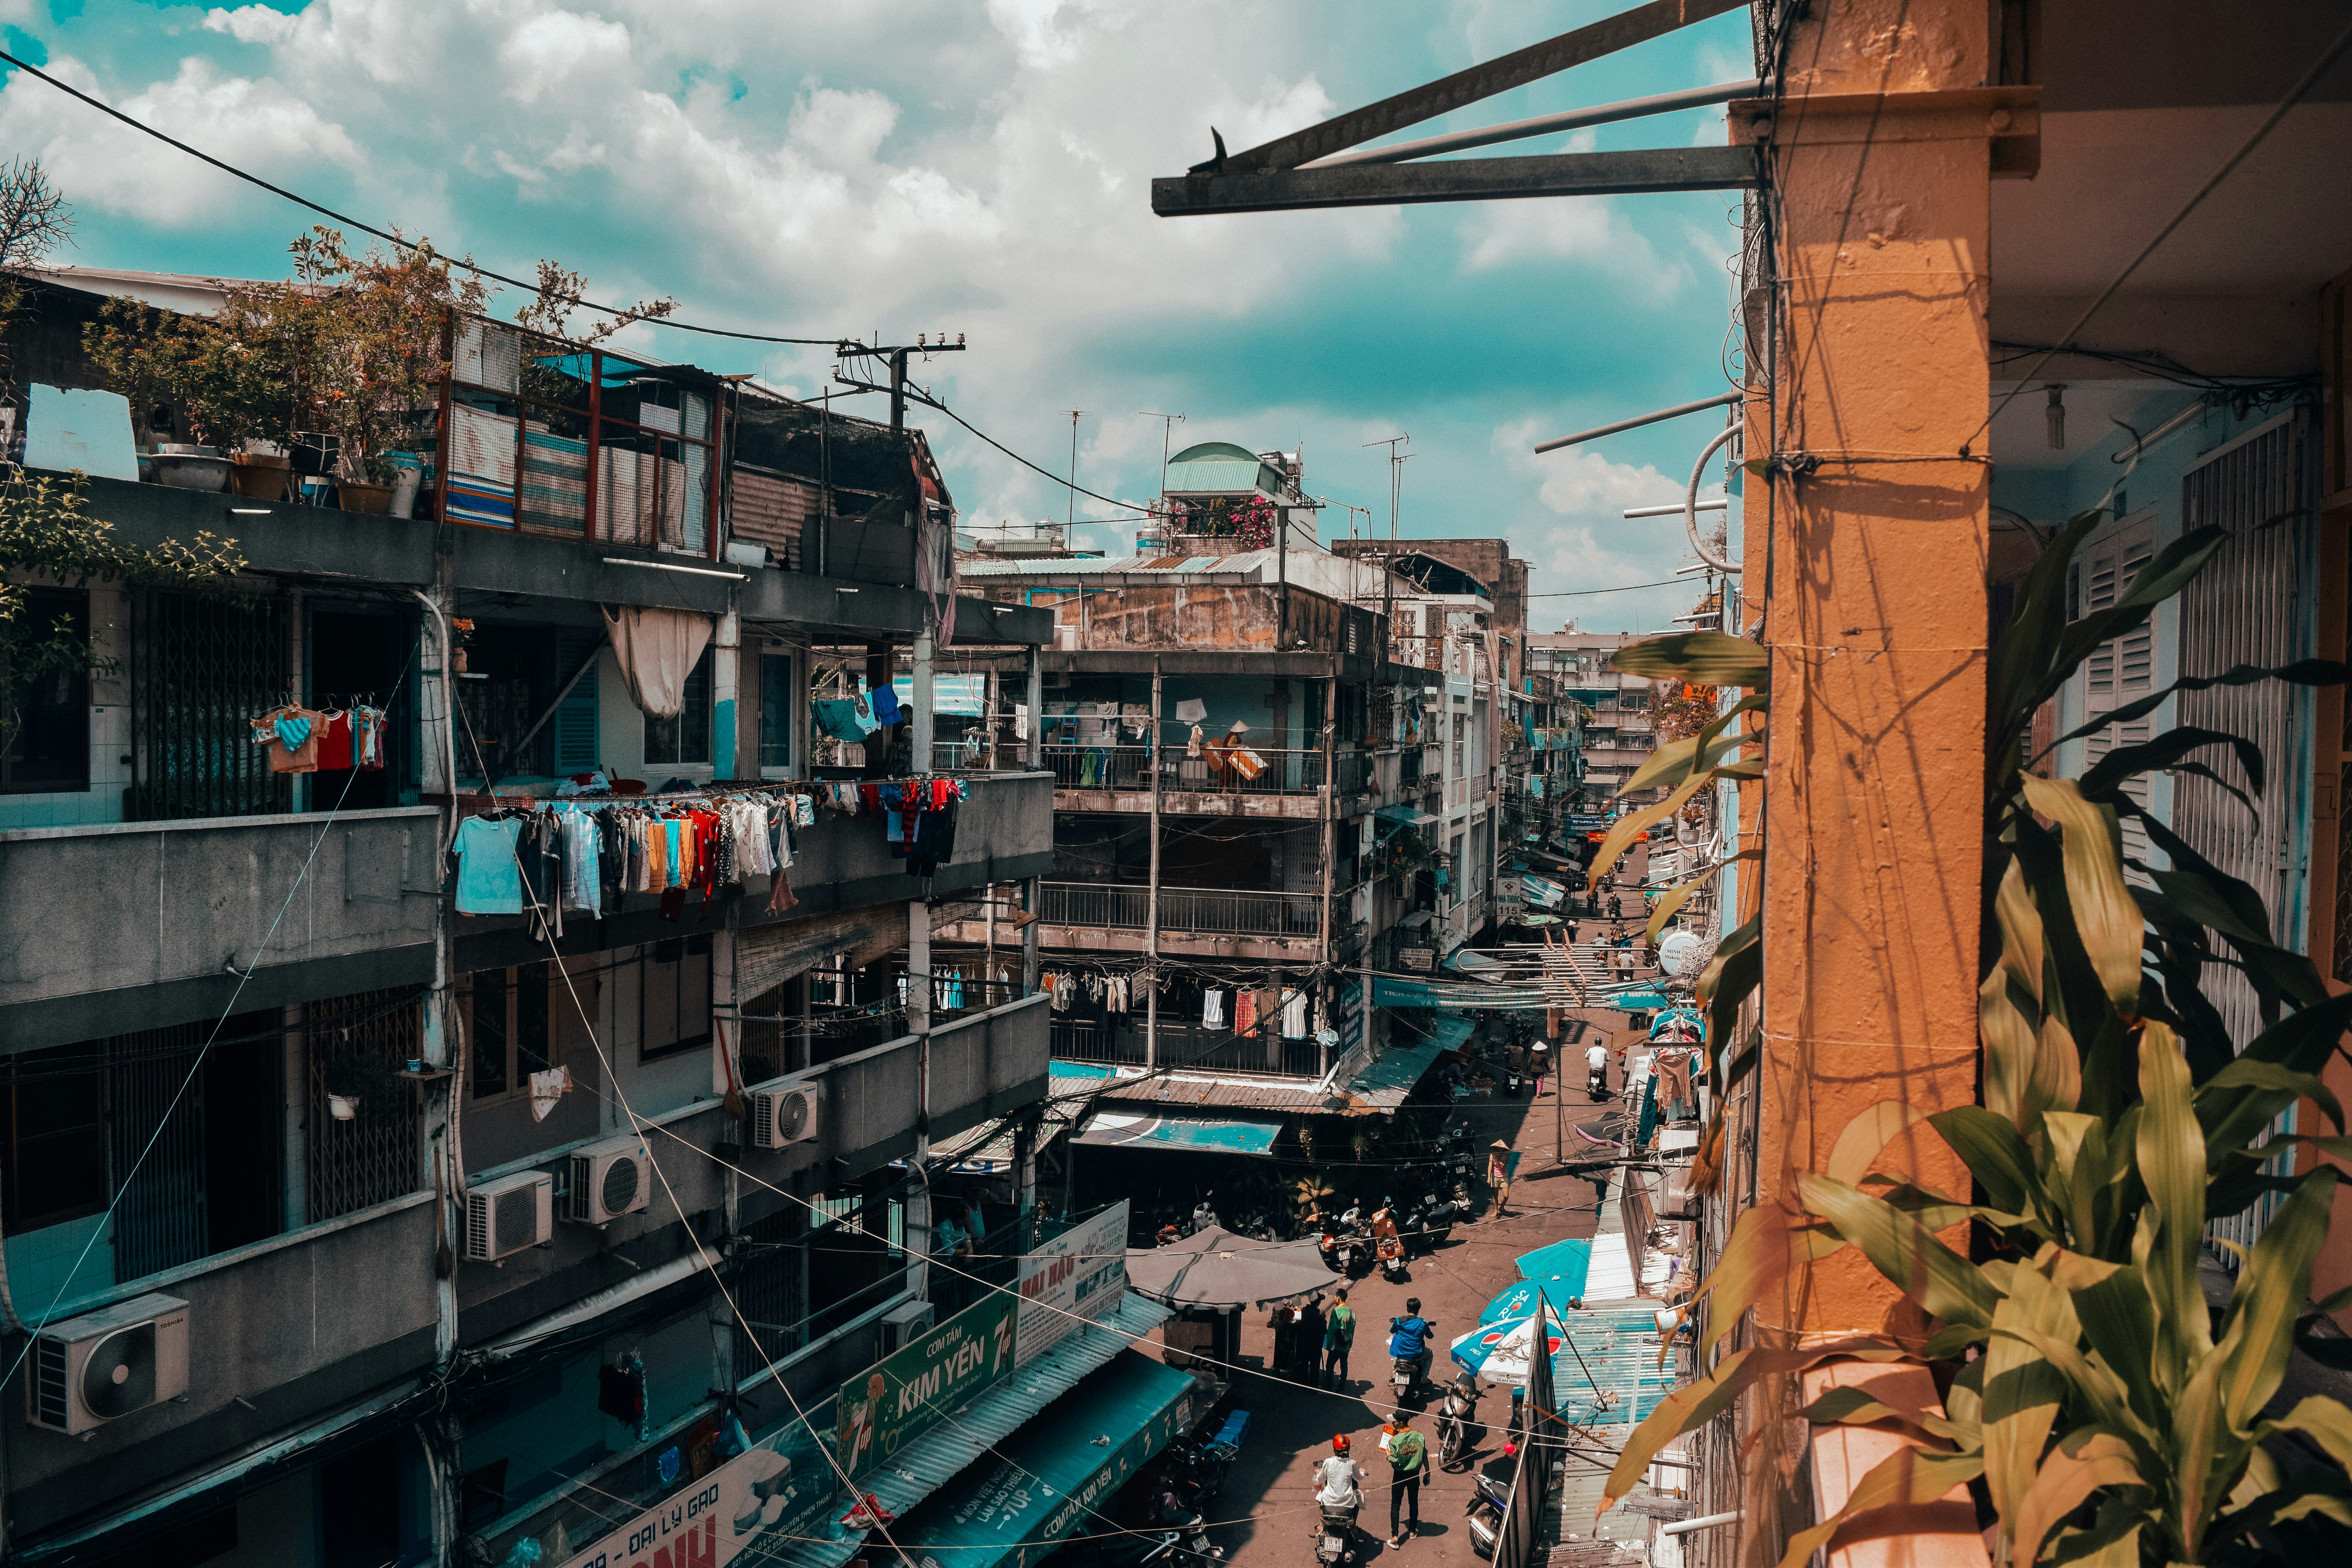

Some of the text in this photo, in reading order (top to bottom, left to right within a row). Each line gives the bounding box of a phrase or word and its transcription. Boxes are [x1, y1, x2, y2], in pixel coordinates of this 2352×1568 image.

[1499, 906, 1517, 915] 115
[1507, 892, 1520, 904] THUỐC
[1171, 1116, 1233, 1126] pepsi
[1021, 1270, 1045, 1304] HAI
[160, 1318, 183, 1329] TOSHIBA
[927, 1325, 962, 1358] CƠM TẤM
[898, 1364, 940, 1419] KIM
[944, 1334, 984, 1386] YẾN
[1096, 1467, 1112, 1490] YẾN
[977, 1468, 1026, 1523] LÀM SAO THIẾU
[1001, 1489, 1032, 1517] 7UP
[629, 1522, 655, 1556] ĐẠI
[662, 1504, 682, 1535] LÝ
[688, 1483, 718, 1518] GẠO
